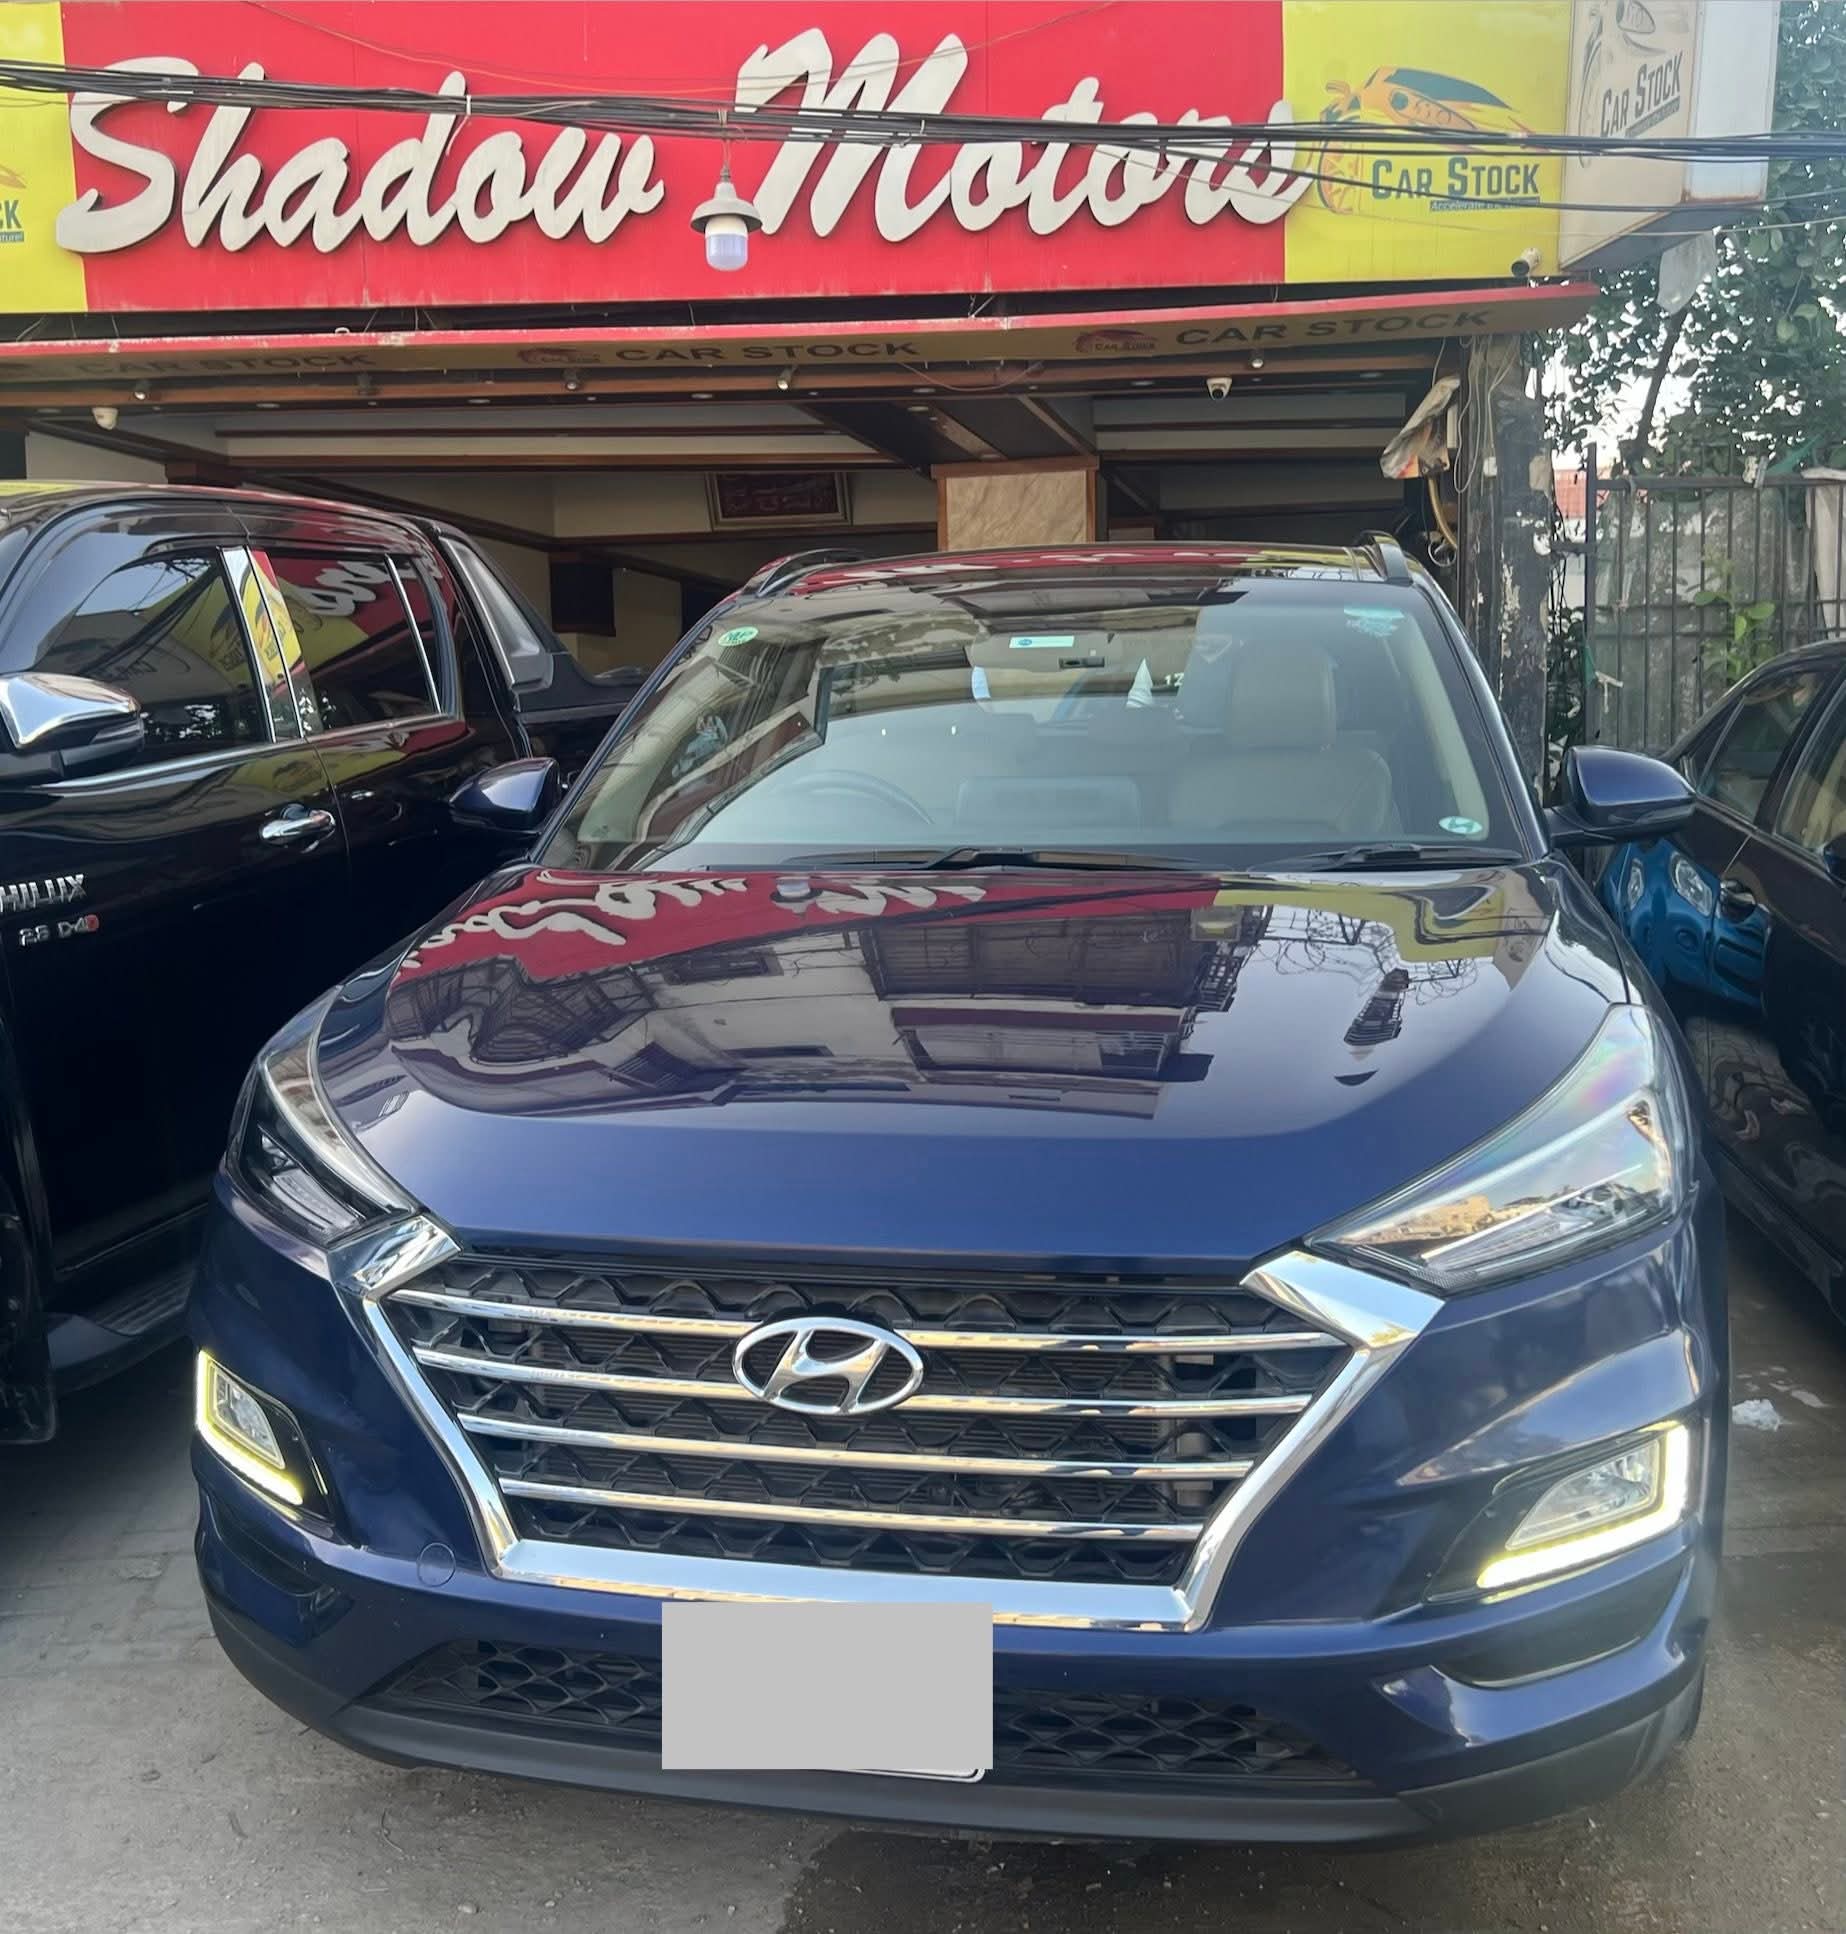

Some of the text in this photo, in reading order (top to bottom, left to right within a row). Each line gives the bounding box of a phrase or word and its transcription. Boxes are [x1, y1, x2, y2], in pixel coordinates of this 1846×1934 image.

[56, 27, 1317, 253] Shadow Motors
[1176, 324, 1288, 346] CAR
[1306, 311, 1491, 336] STOCK
[201, 352, 378, 372] STOCK
[616, 347, 728, 361] CAR
[741, 341, 921, 360] STOCK
[0, 874, 87, 913] HILUX
